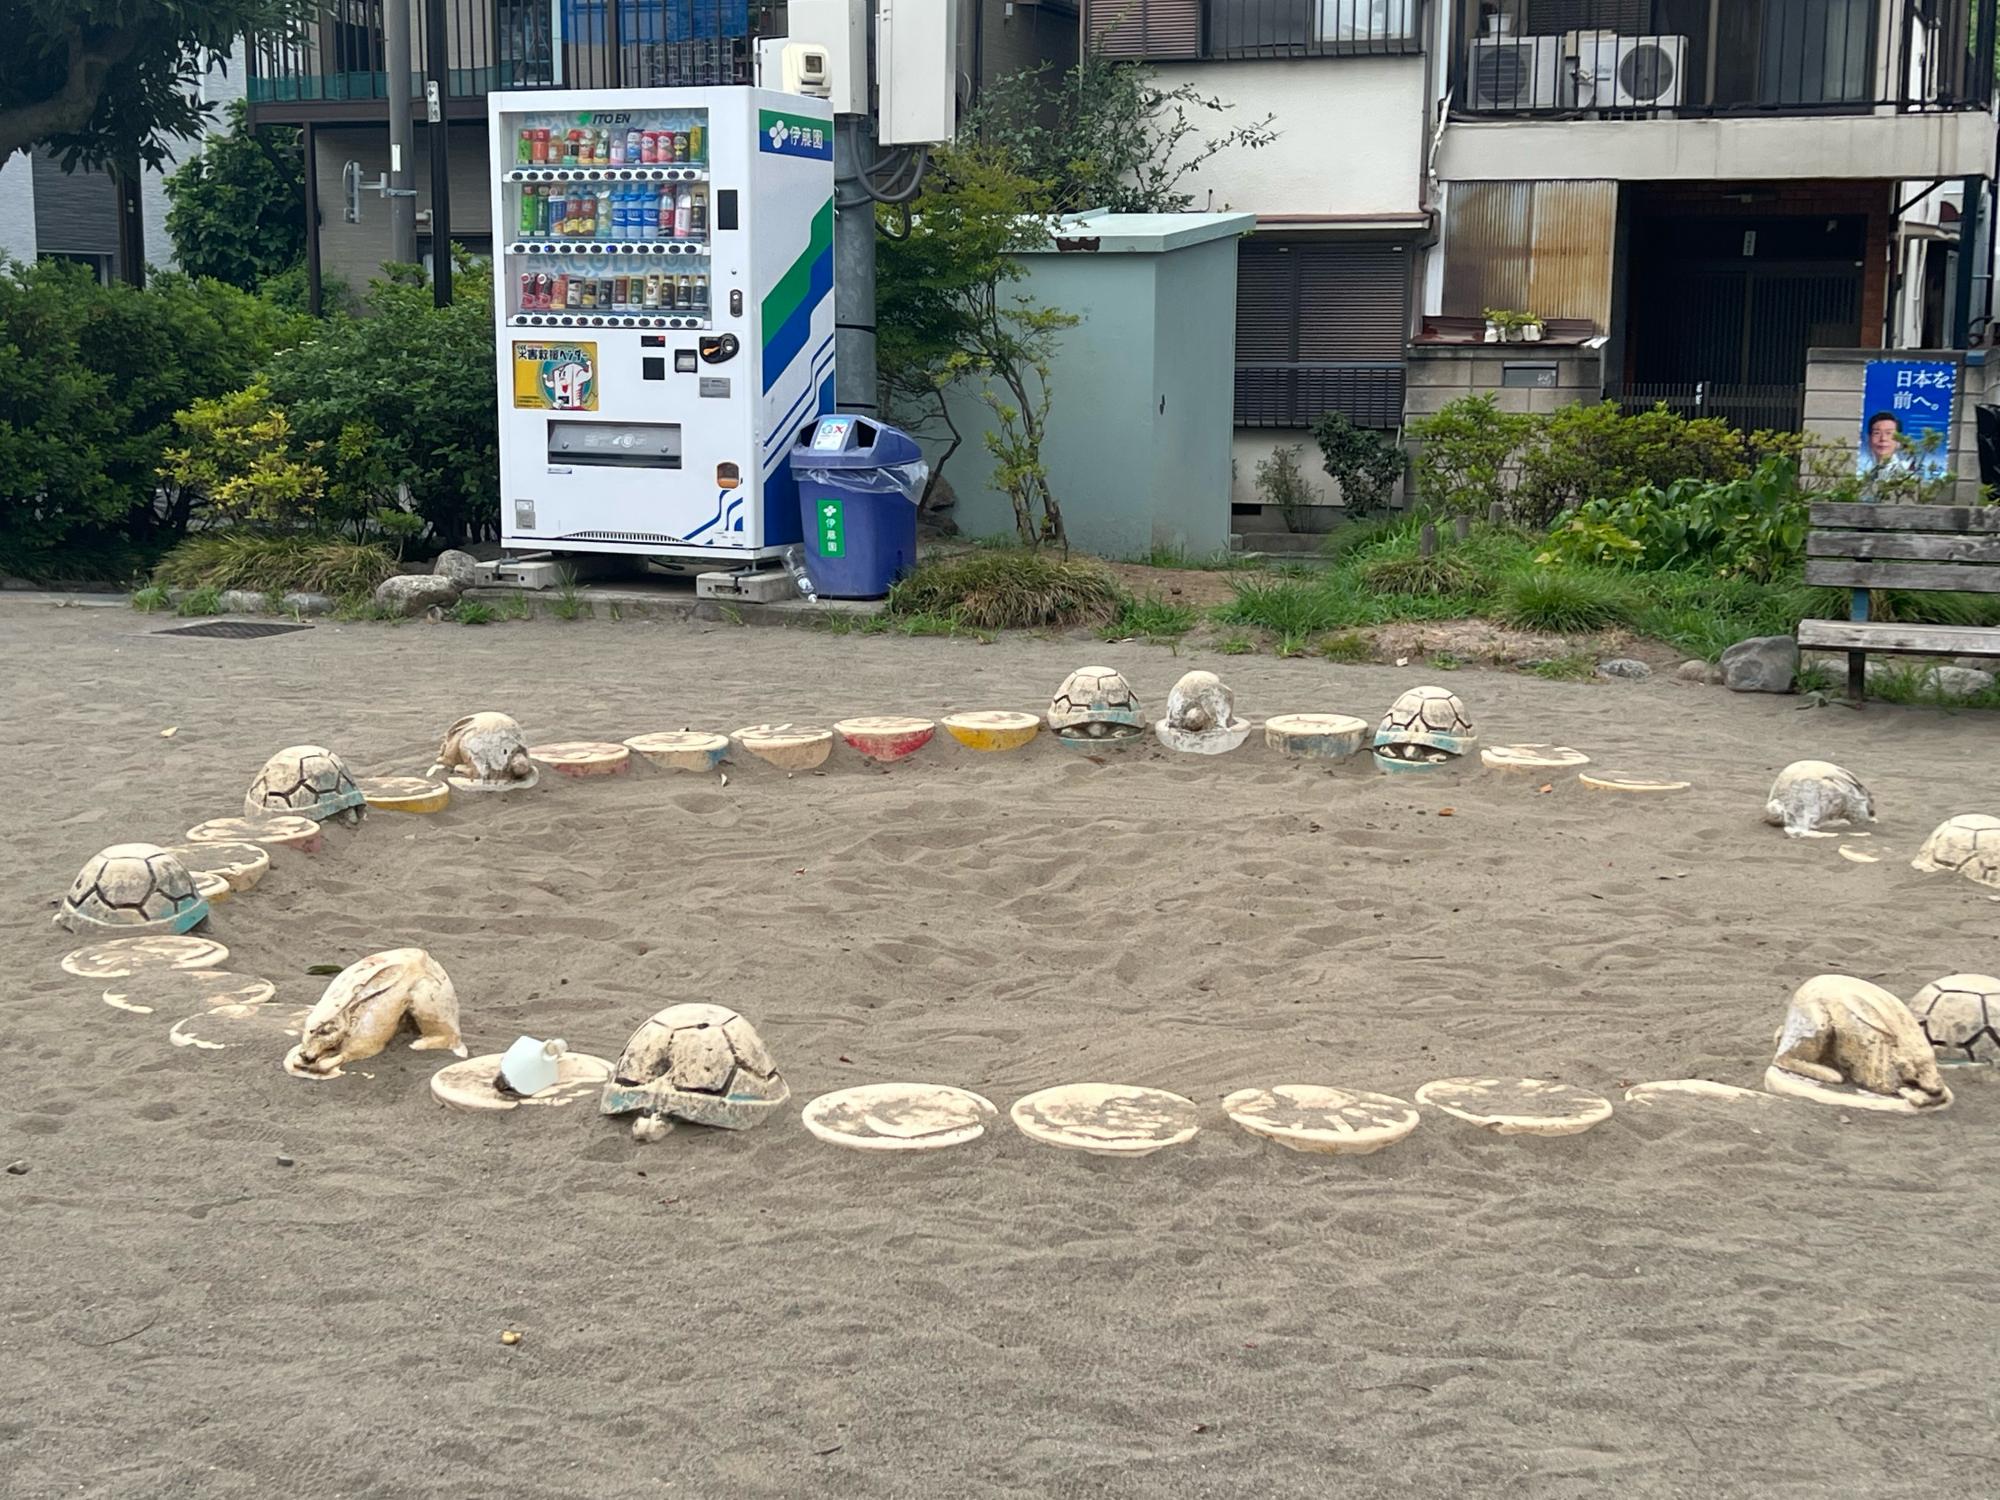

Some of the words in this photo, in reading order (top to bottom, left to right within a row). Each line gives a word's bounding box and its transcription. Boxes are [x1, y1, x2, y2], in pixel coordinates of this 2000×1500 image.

[592, 113, 613, 124] ITO
[615, 113, 631, 124] EN
[789, 125, 823, 149] 伊藤園
[1897, 370, 1952, 388] 日本を、
[1893, 391, 1939, 410] 前へ。
